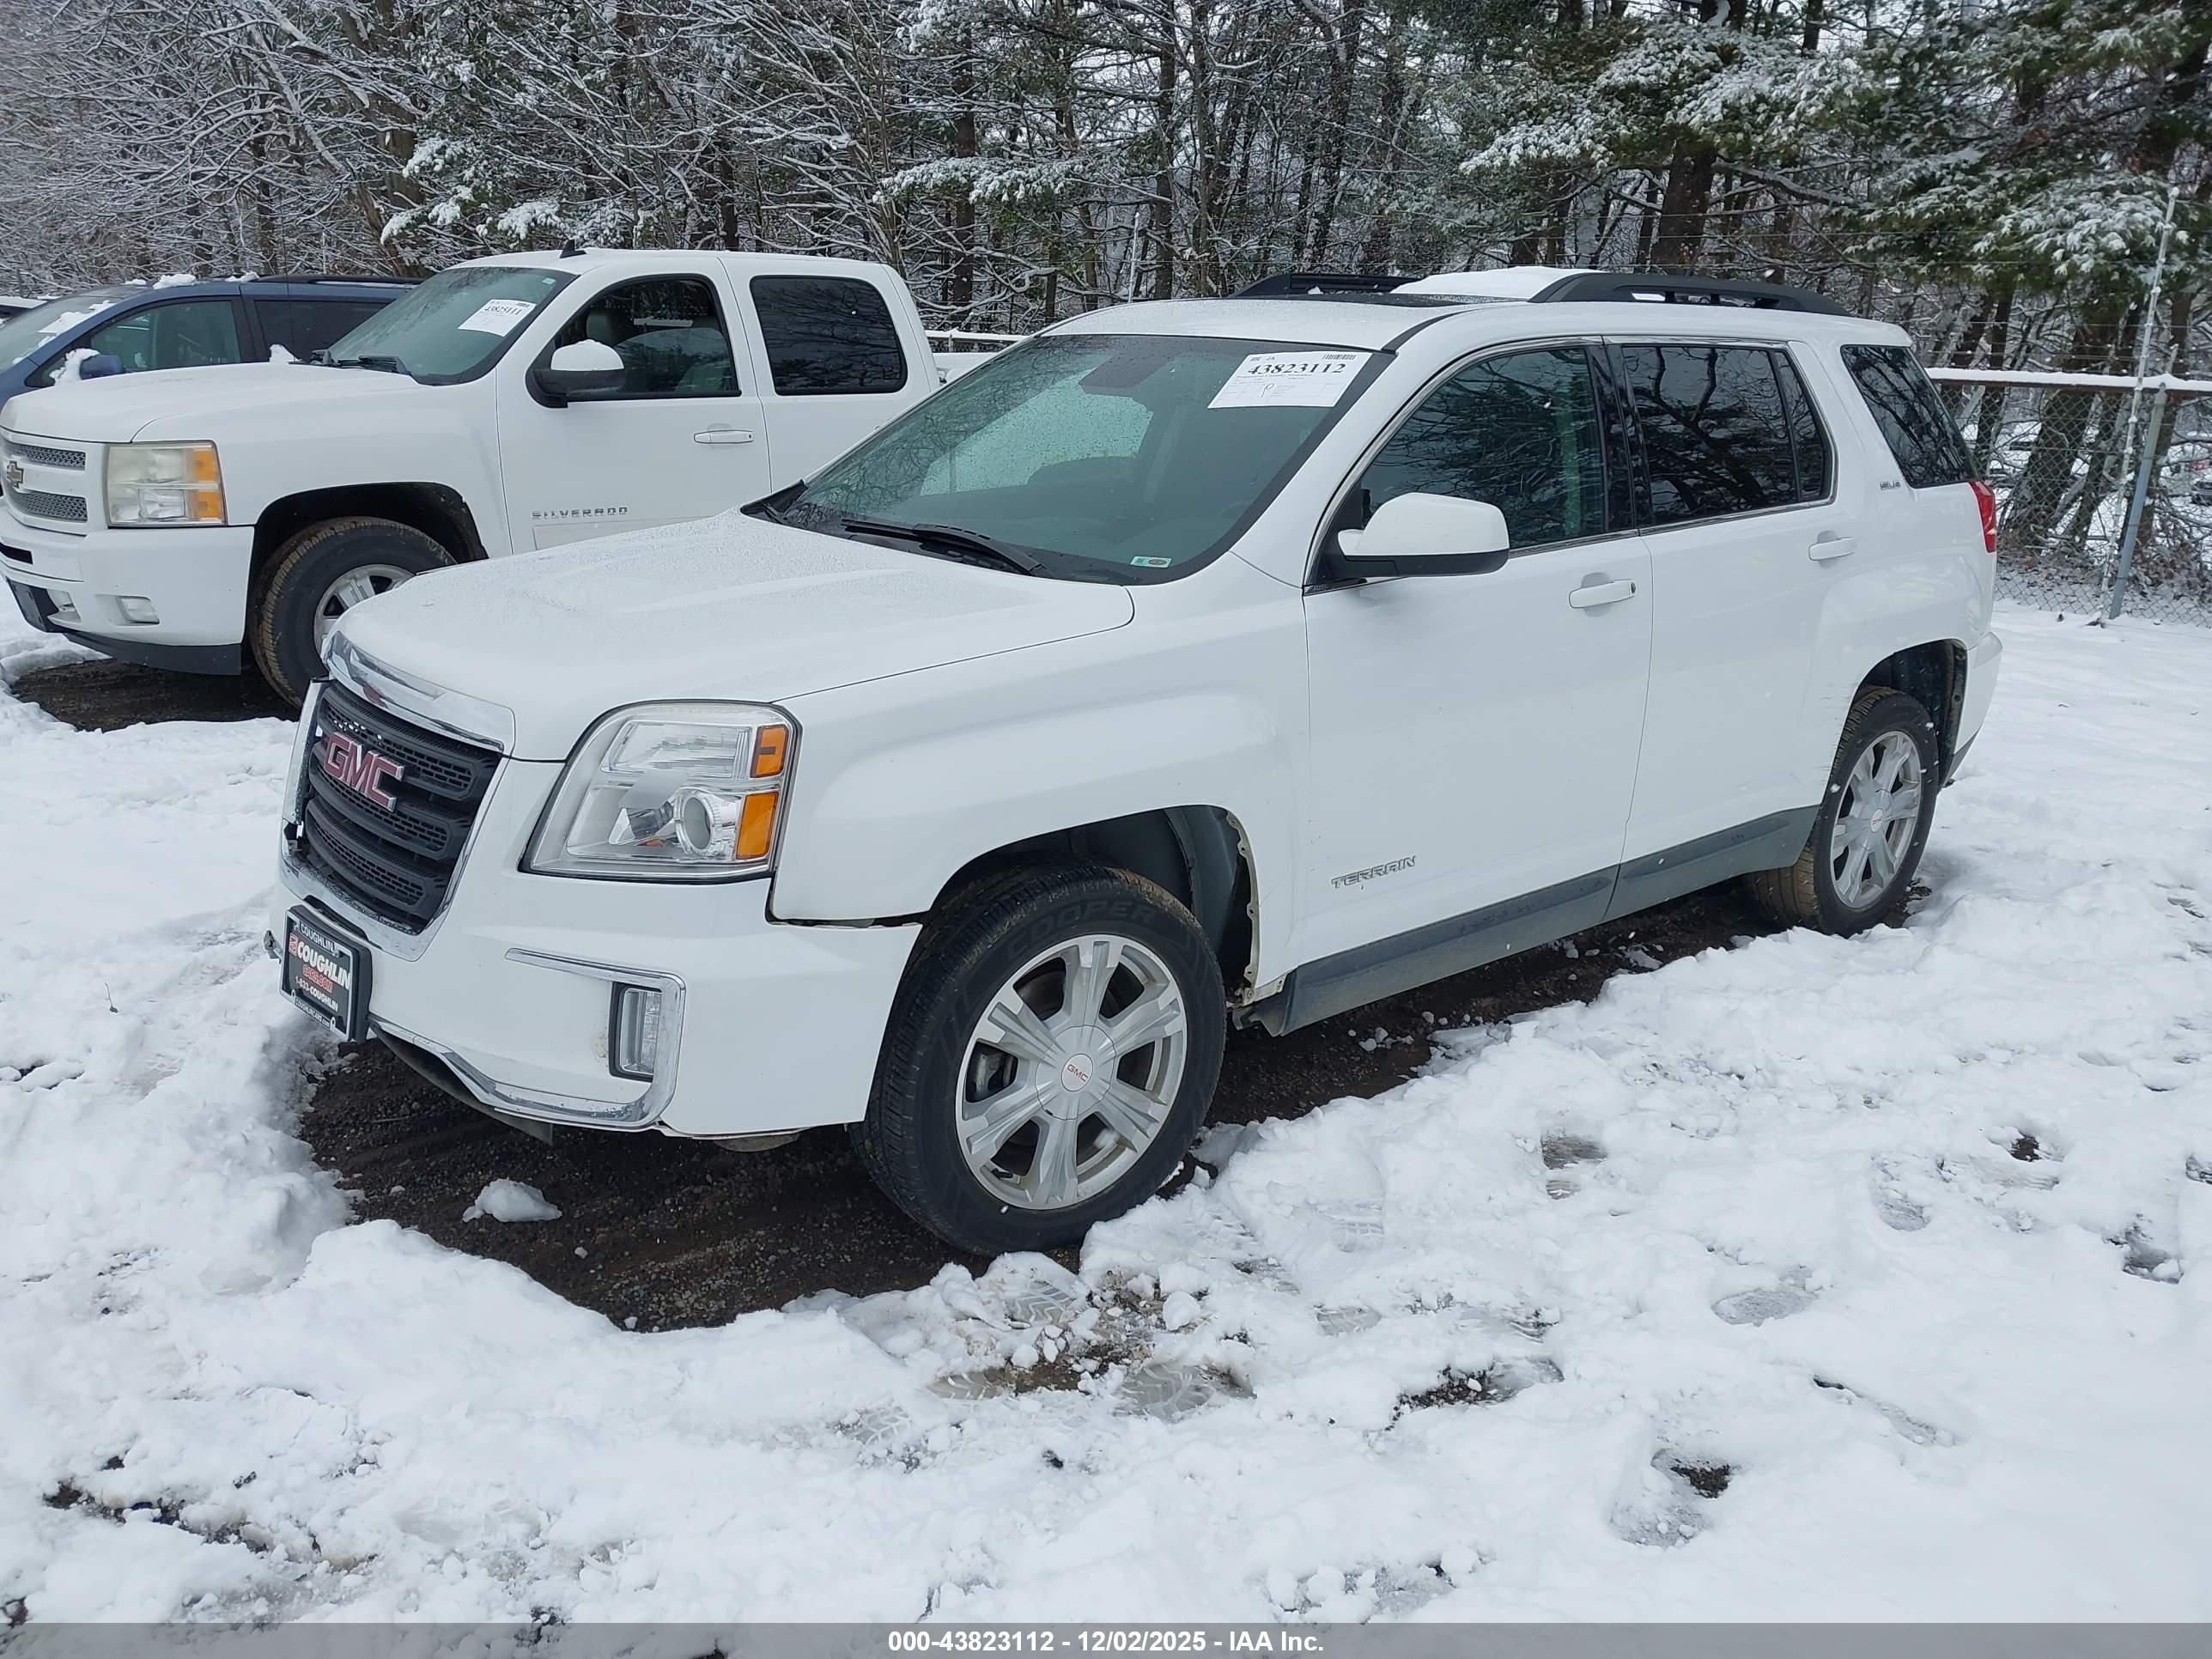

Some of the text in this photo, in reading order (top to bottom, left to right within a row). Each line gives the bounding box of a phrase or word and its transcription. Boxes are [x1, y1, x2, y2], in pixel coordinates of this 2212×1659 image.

[1248, 363, 1346, 374] 43823112
[532, 507, 628, 520] SILVERADO
[324, 732, 404, 812] GMC
[1331, 855, 1416, 889] TERRAIN
[301, 923, 336, 953] COUGHLIN
[1006, 899, 1157, 959] COOPER
[297, 941, 350, 990] COUGHLIN
[1066, 1064, 1089, 1082] GMC
